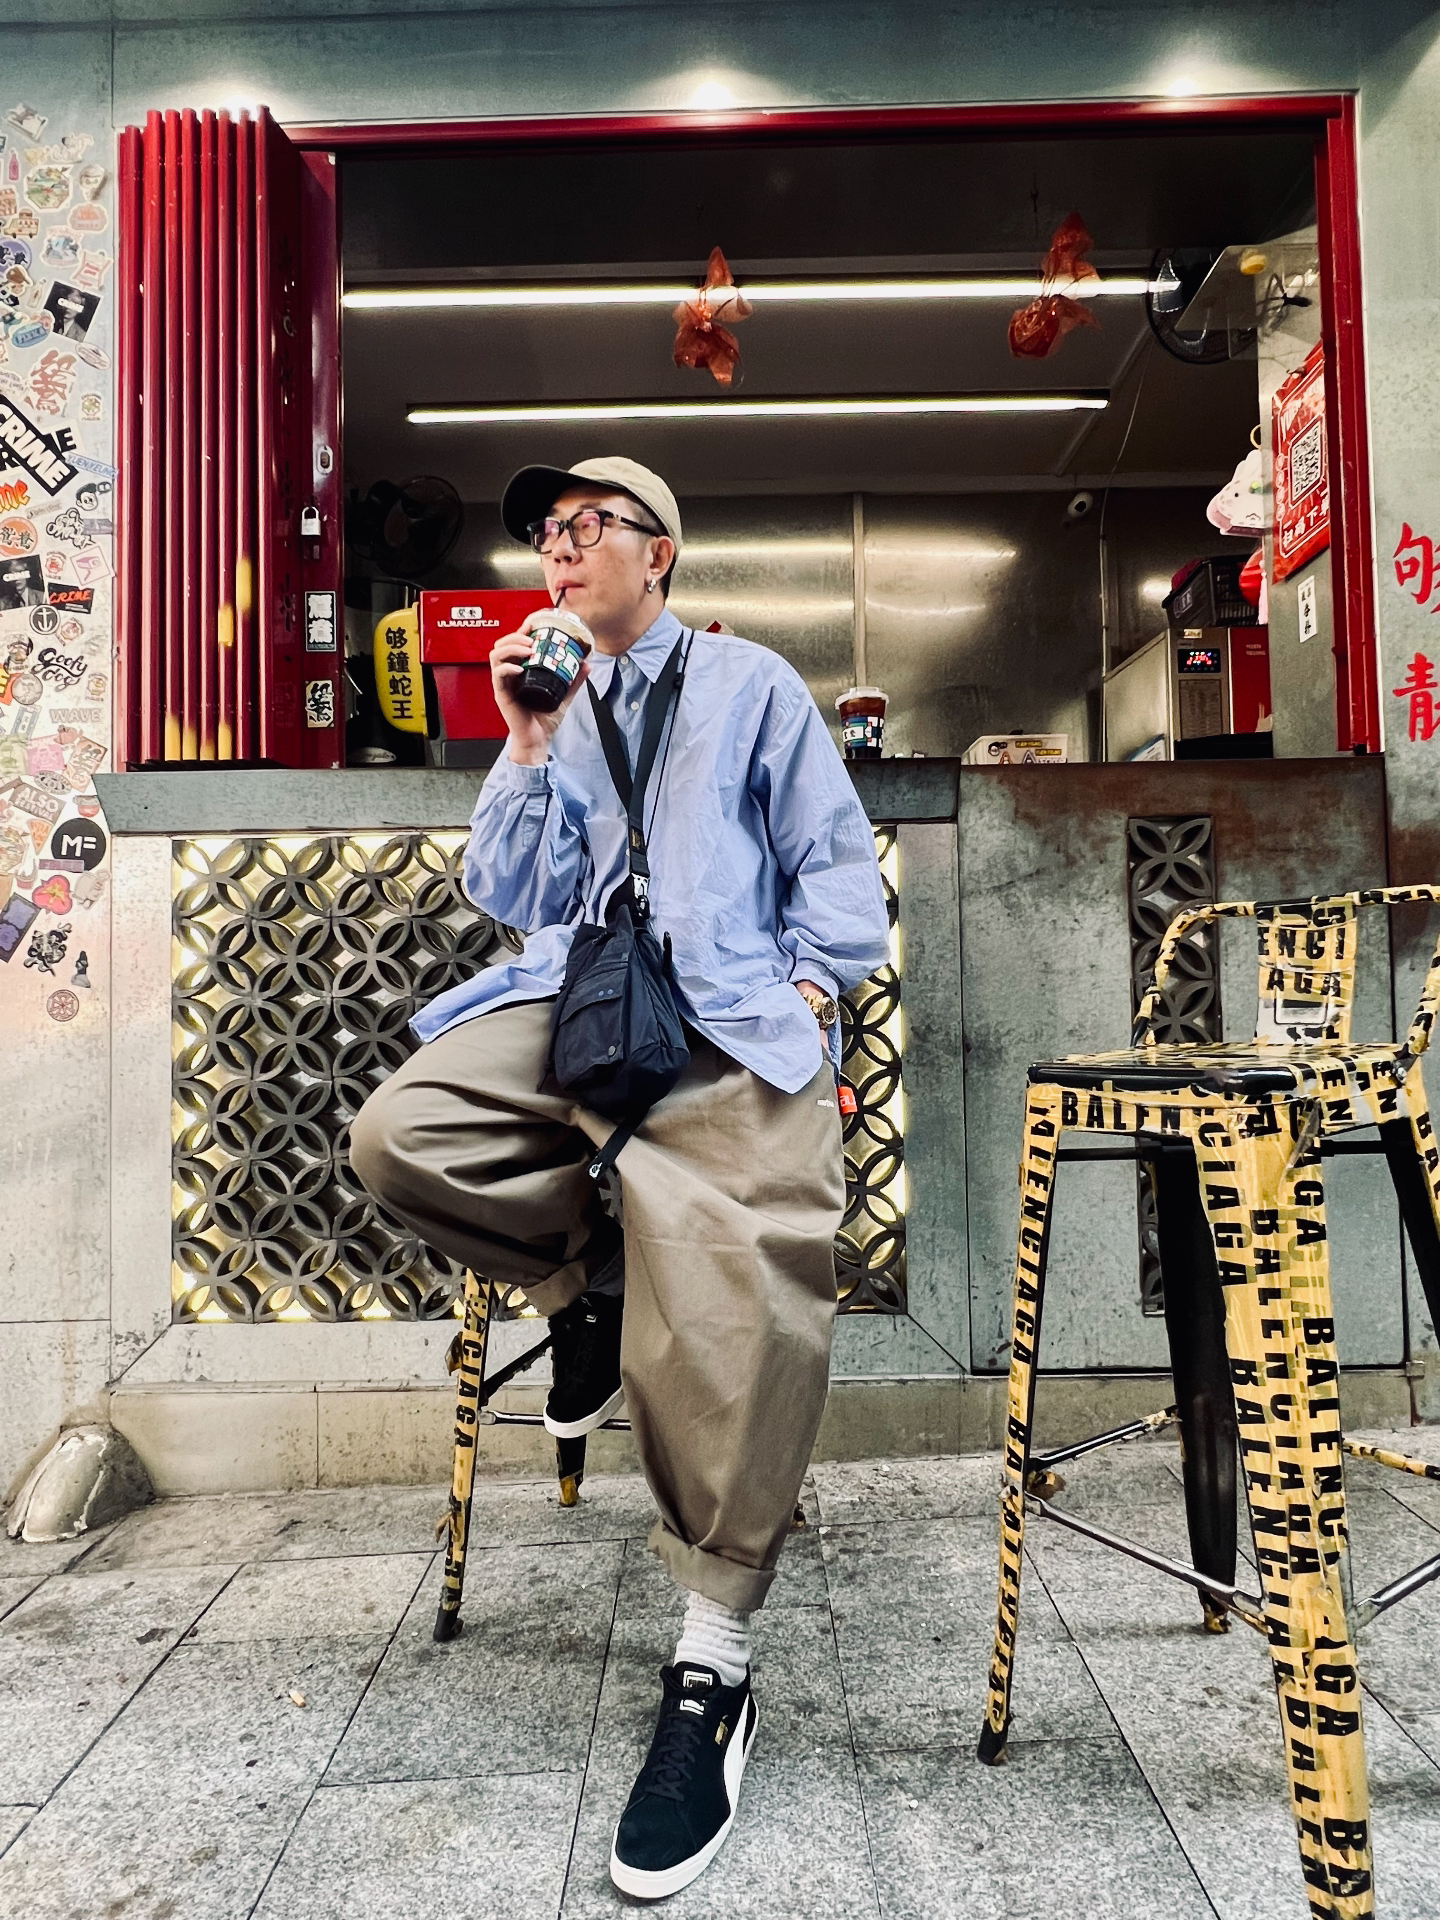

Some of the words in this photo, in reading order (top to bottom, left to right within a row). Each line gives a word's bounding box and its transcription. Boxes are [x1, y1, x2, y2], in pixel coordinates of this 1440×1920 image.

[67, 453, 90, 471] YUEN
[50, 589, 92, 604] CRIME
[385, 626, 413, 719] 够鐘蛇王
[51, 708, 101, 723] WAVE
[17, 786, 60, 813] ALSO
